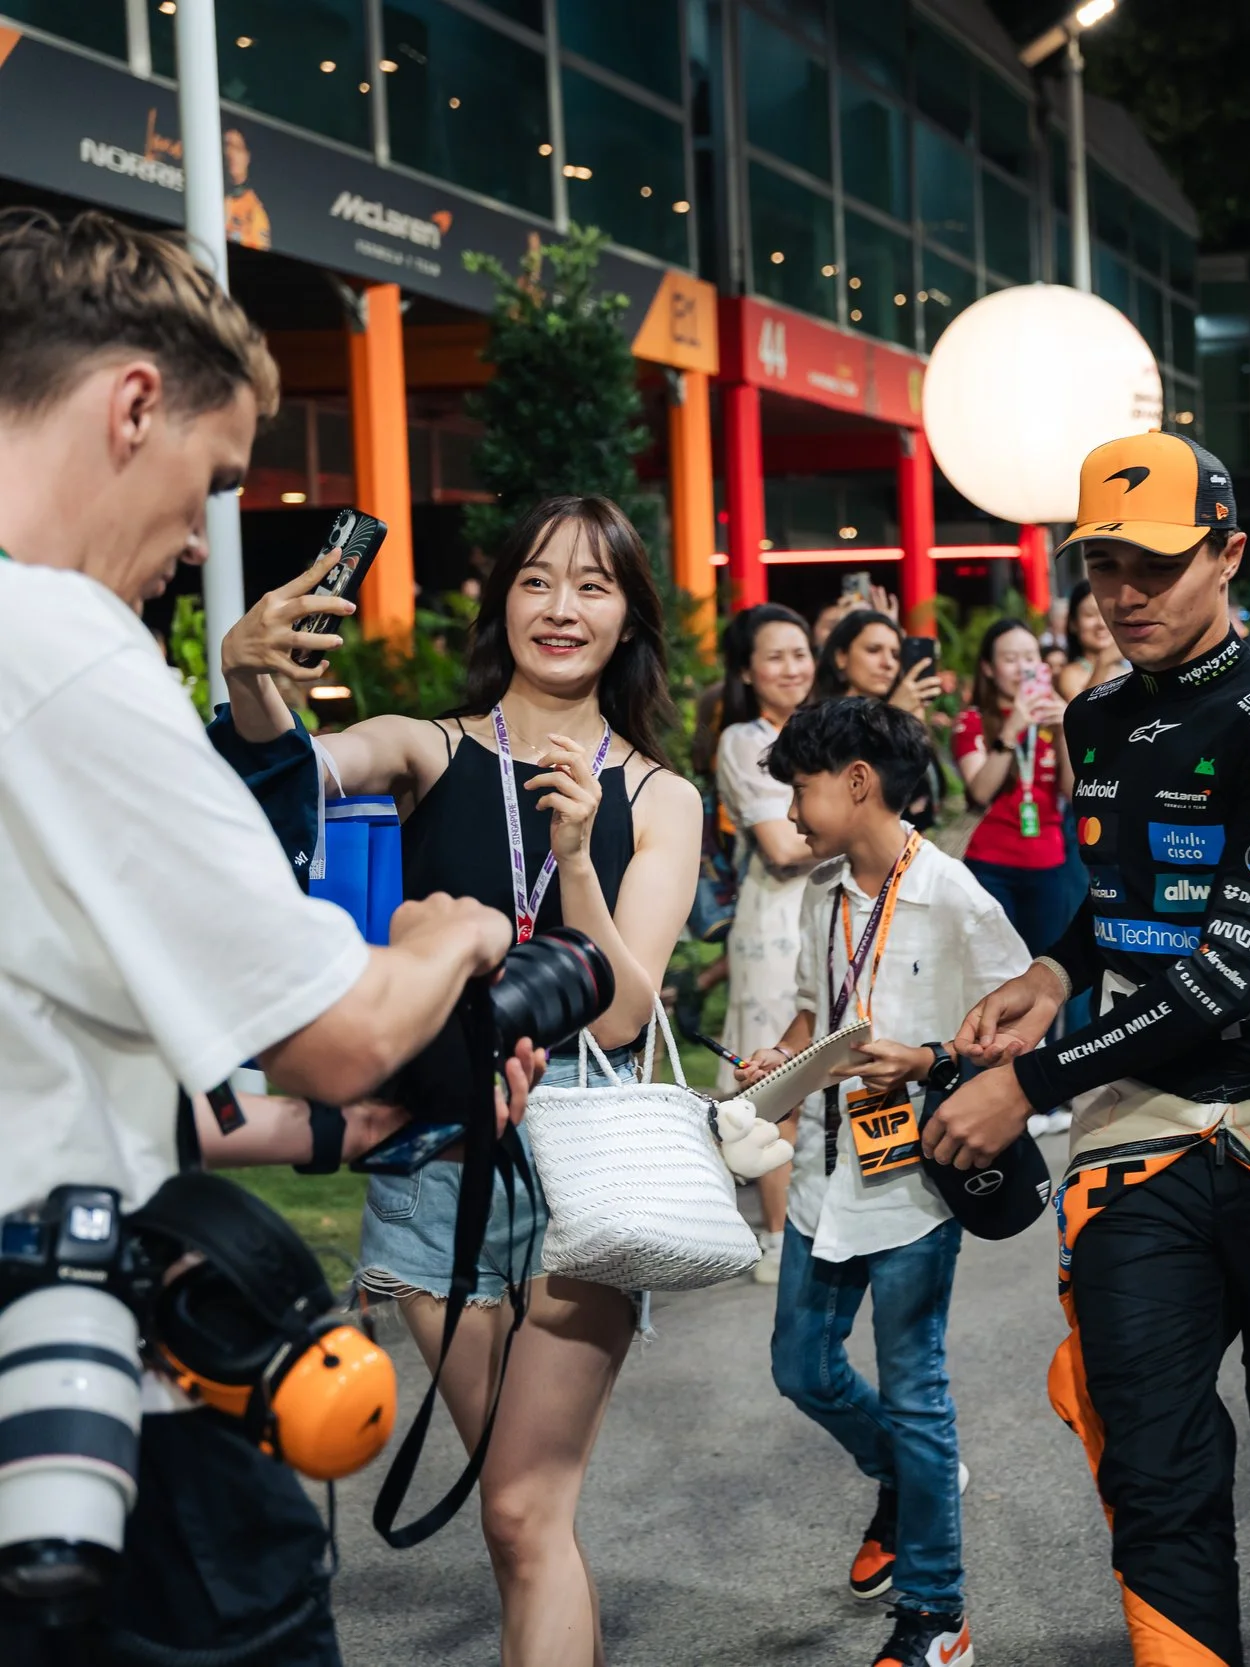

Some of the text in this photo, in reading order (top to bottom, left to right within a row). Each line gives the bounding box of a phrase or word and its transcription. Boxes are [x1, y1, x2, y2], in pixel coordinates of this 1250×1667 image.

[329, 190, 441, 250] McLaren
[758, 318, 788, 380] 44
[1095, 522, 1124, 532] 4
[1178, 640, 1241, 685] MONSTER
[1075, 779, 1119, 798] Android
[1155, 790, 1208, 802] McLaren
[509, 802, 521, 846] SINGAPORE
[1168, 848, 1203, 859] CISCO
[1204, 951, 1248, 990] Airwallex
[1057, 1001, 1173, 1065] RICHARD MILLE
[858, 1110, 911, 1139] VIP
